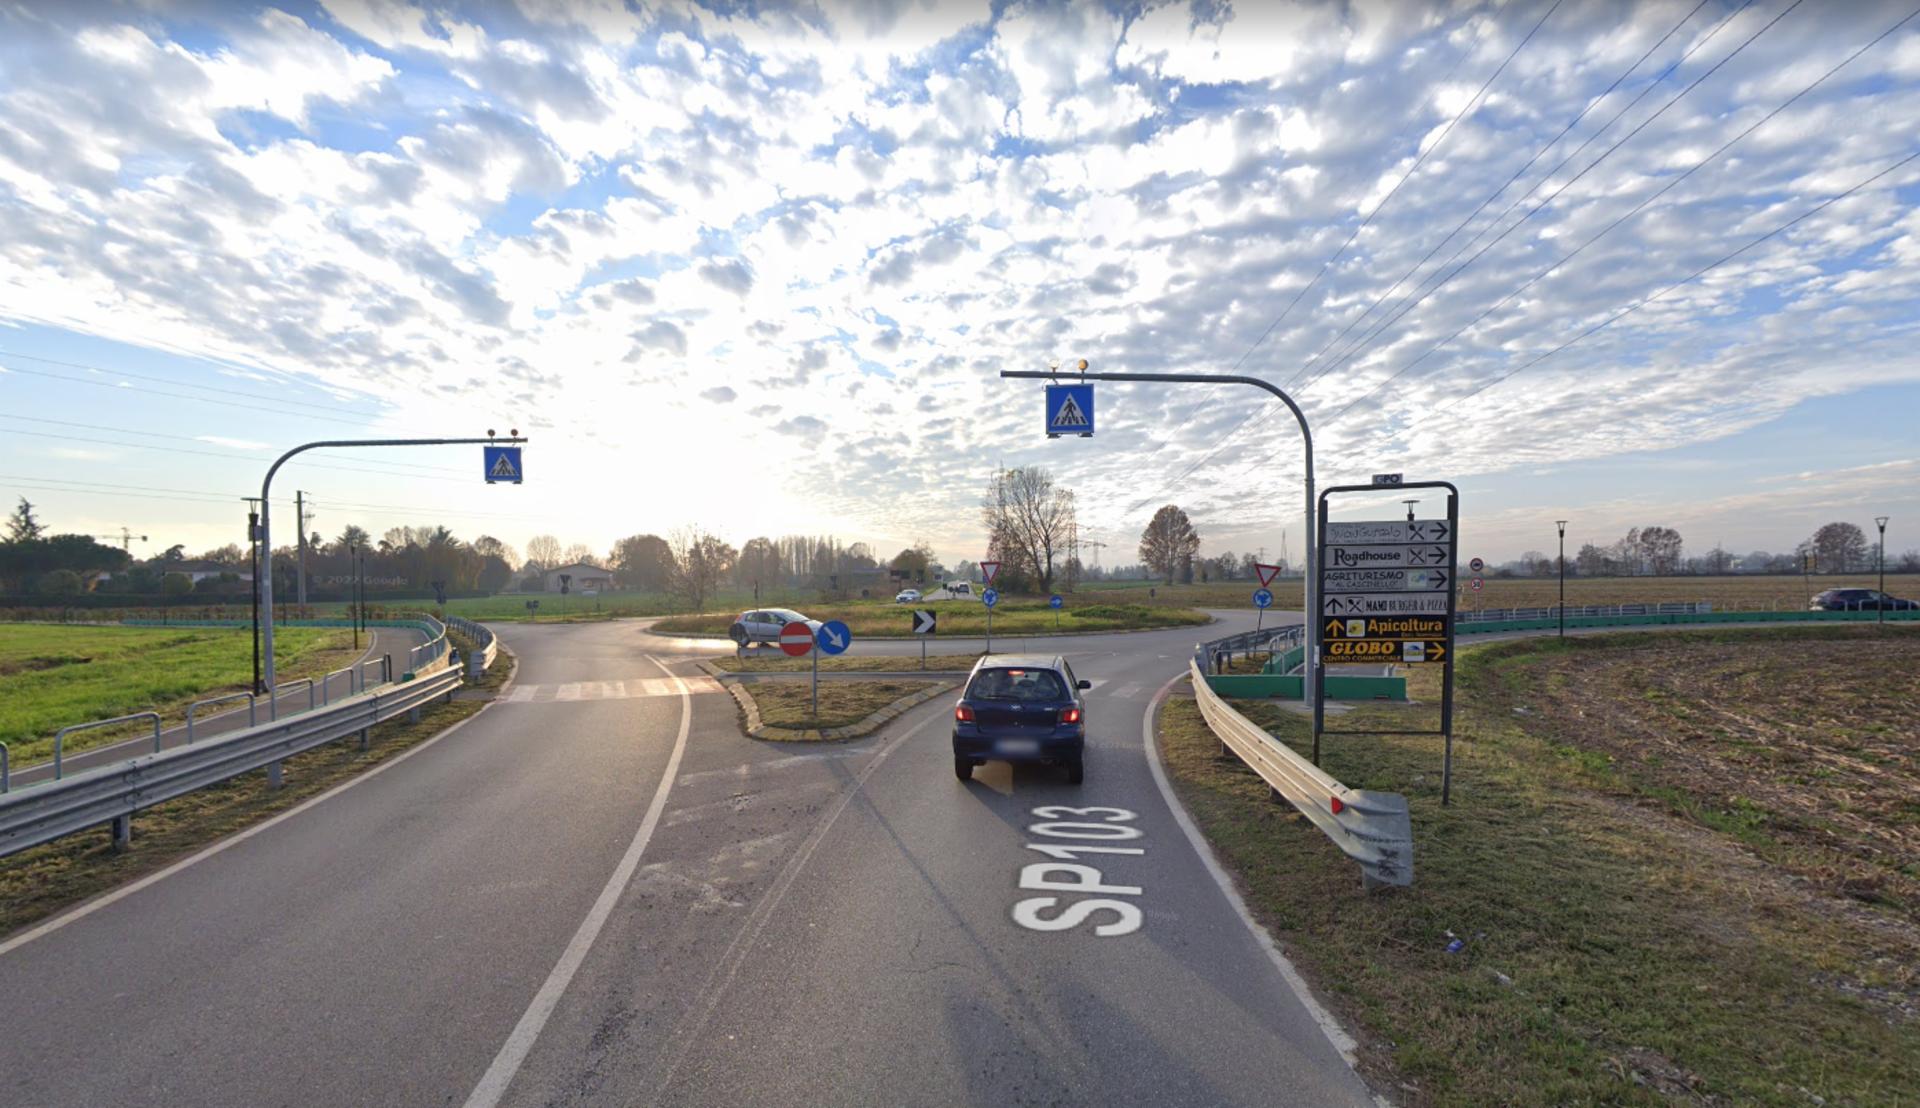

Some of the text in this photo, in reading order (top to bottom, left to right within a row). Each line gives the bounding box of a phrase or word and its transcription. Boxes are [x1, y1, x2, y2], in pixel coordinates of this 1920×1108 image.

[1333, 548, 1400, 566] Roadhouse
[1325, 571, 1404, 581] AGRITURISMO
[1368, 619, 1443, 635] Apicoltura
[1330, 642, 1395, 655] GLOBO
